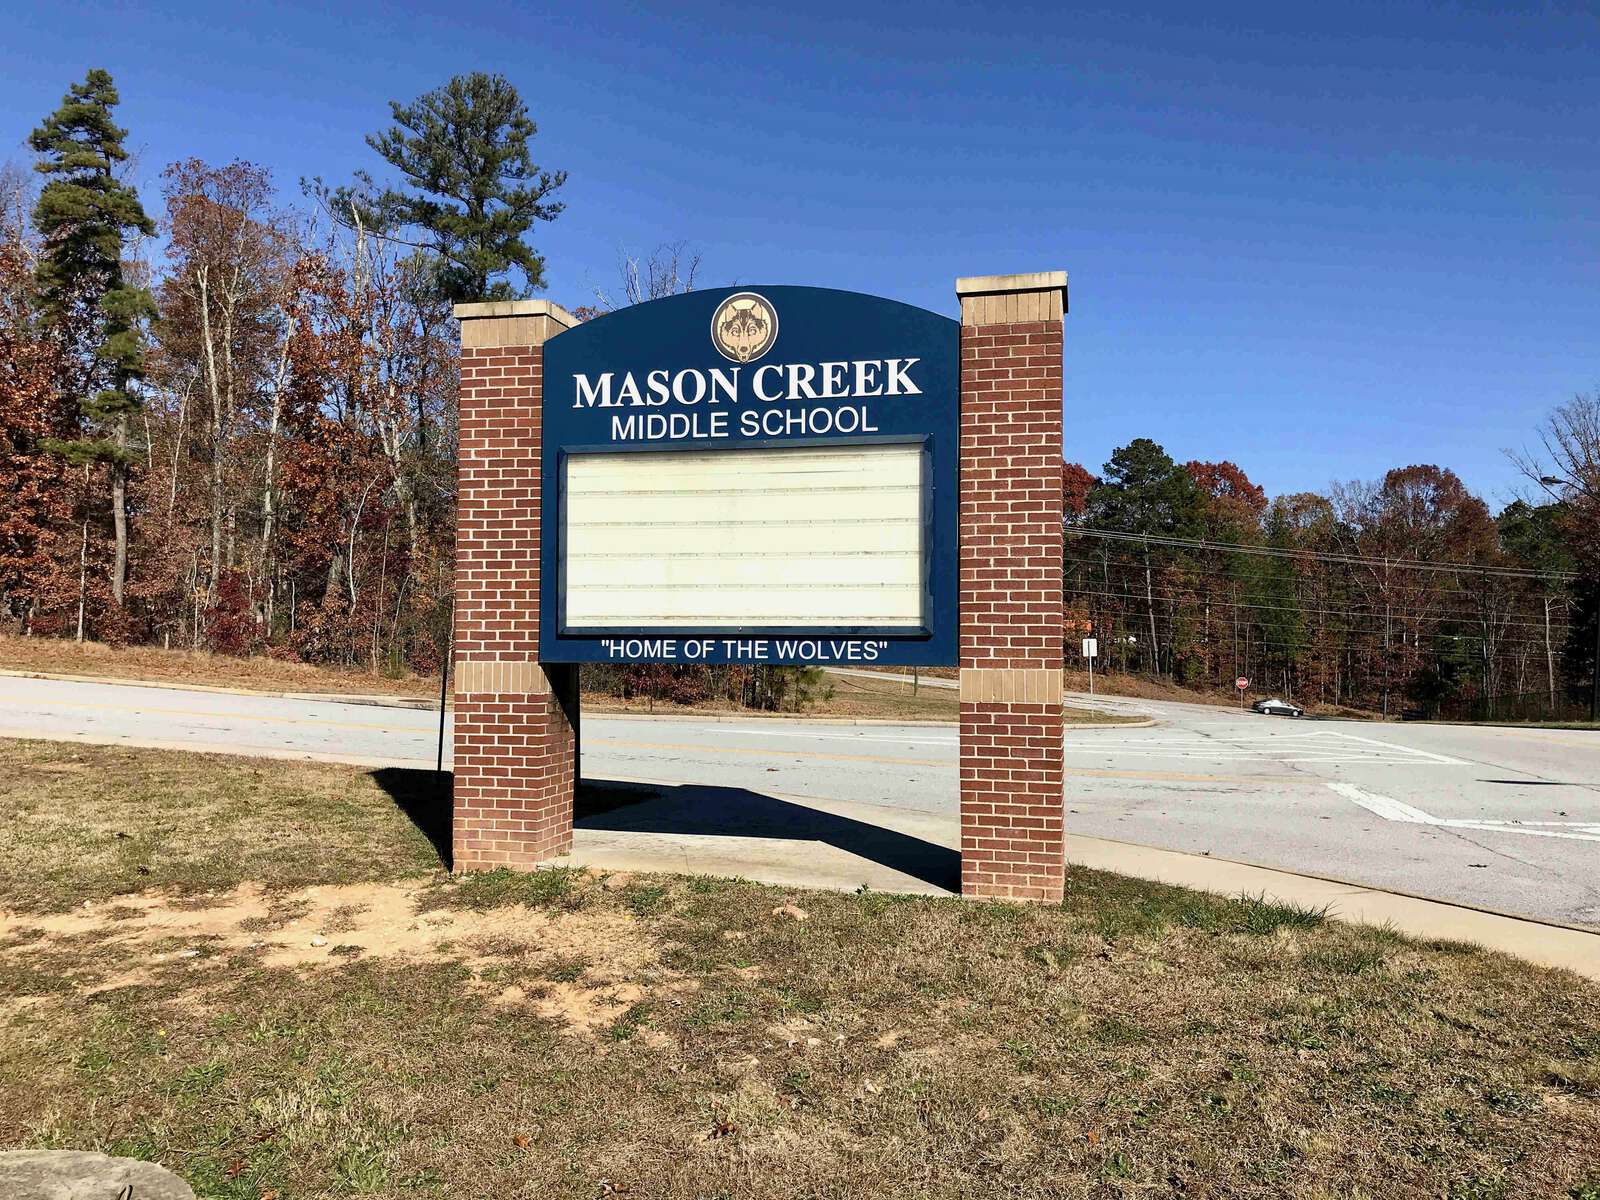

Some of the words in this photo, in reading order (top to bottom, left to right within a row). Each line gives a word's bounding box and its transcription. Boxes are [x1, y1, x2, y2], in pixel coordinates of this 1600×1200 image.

[572, 368, 741, 409] MASON
[752, 358, 923, 401] CREEK
[611, 411, 729, 440] MIDDLE
[740, 406, 879, 437] SCHOOL
[601, 639, 677, 659] "HOME
[683, 639, 716, 659] OF
[722, 640, 769, 659] THE
[775, 640, 888, 660] WOLVES"
